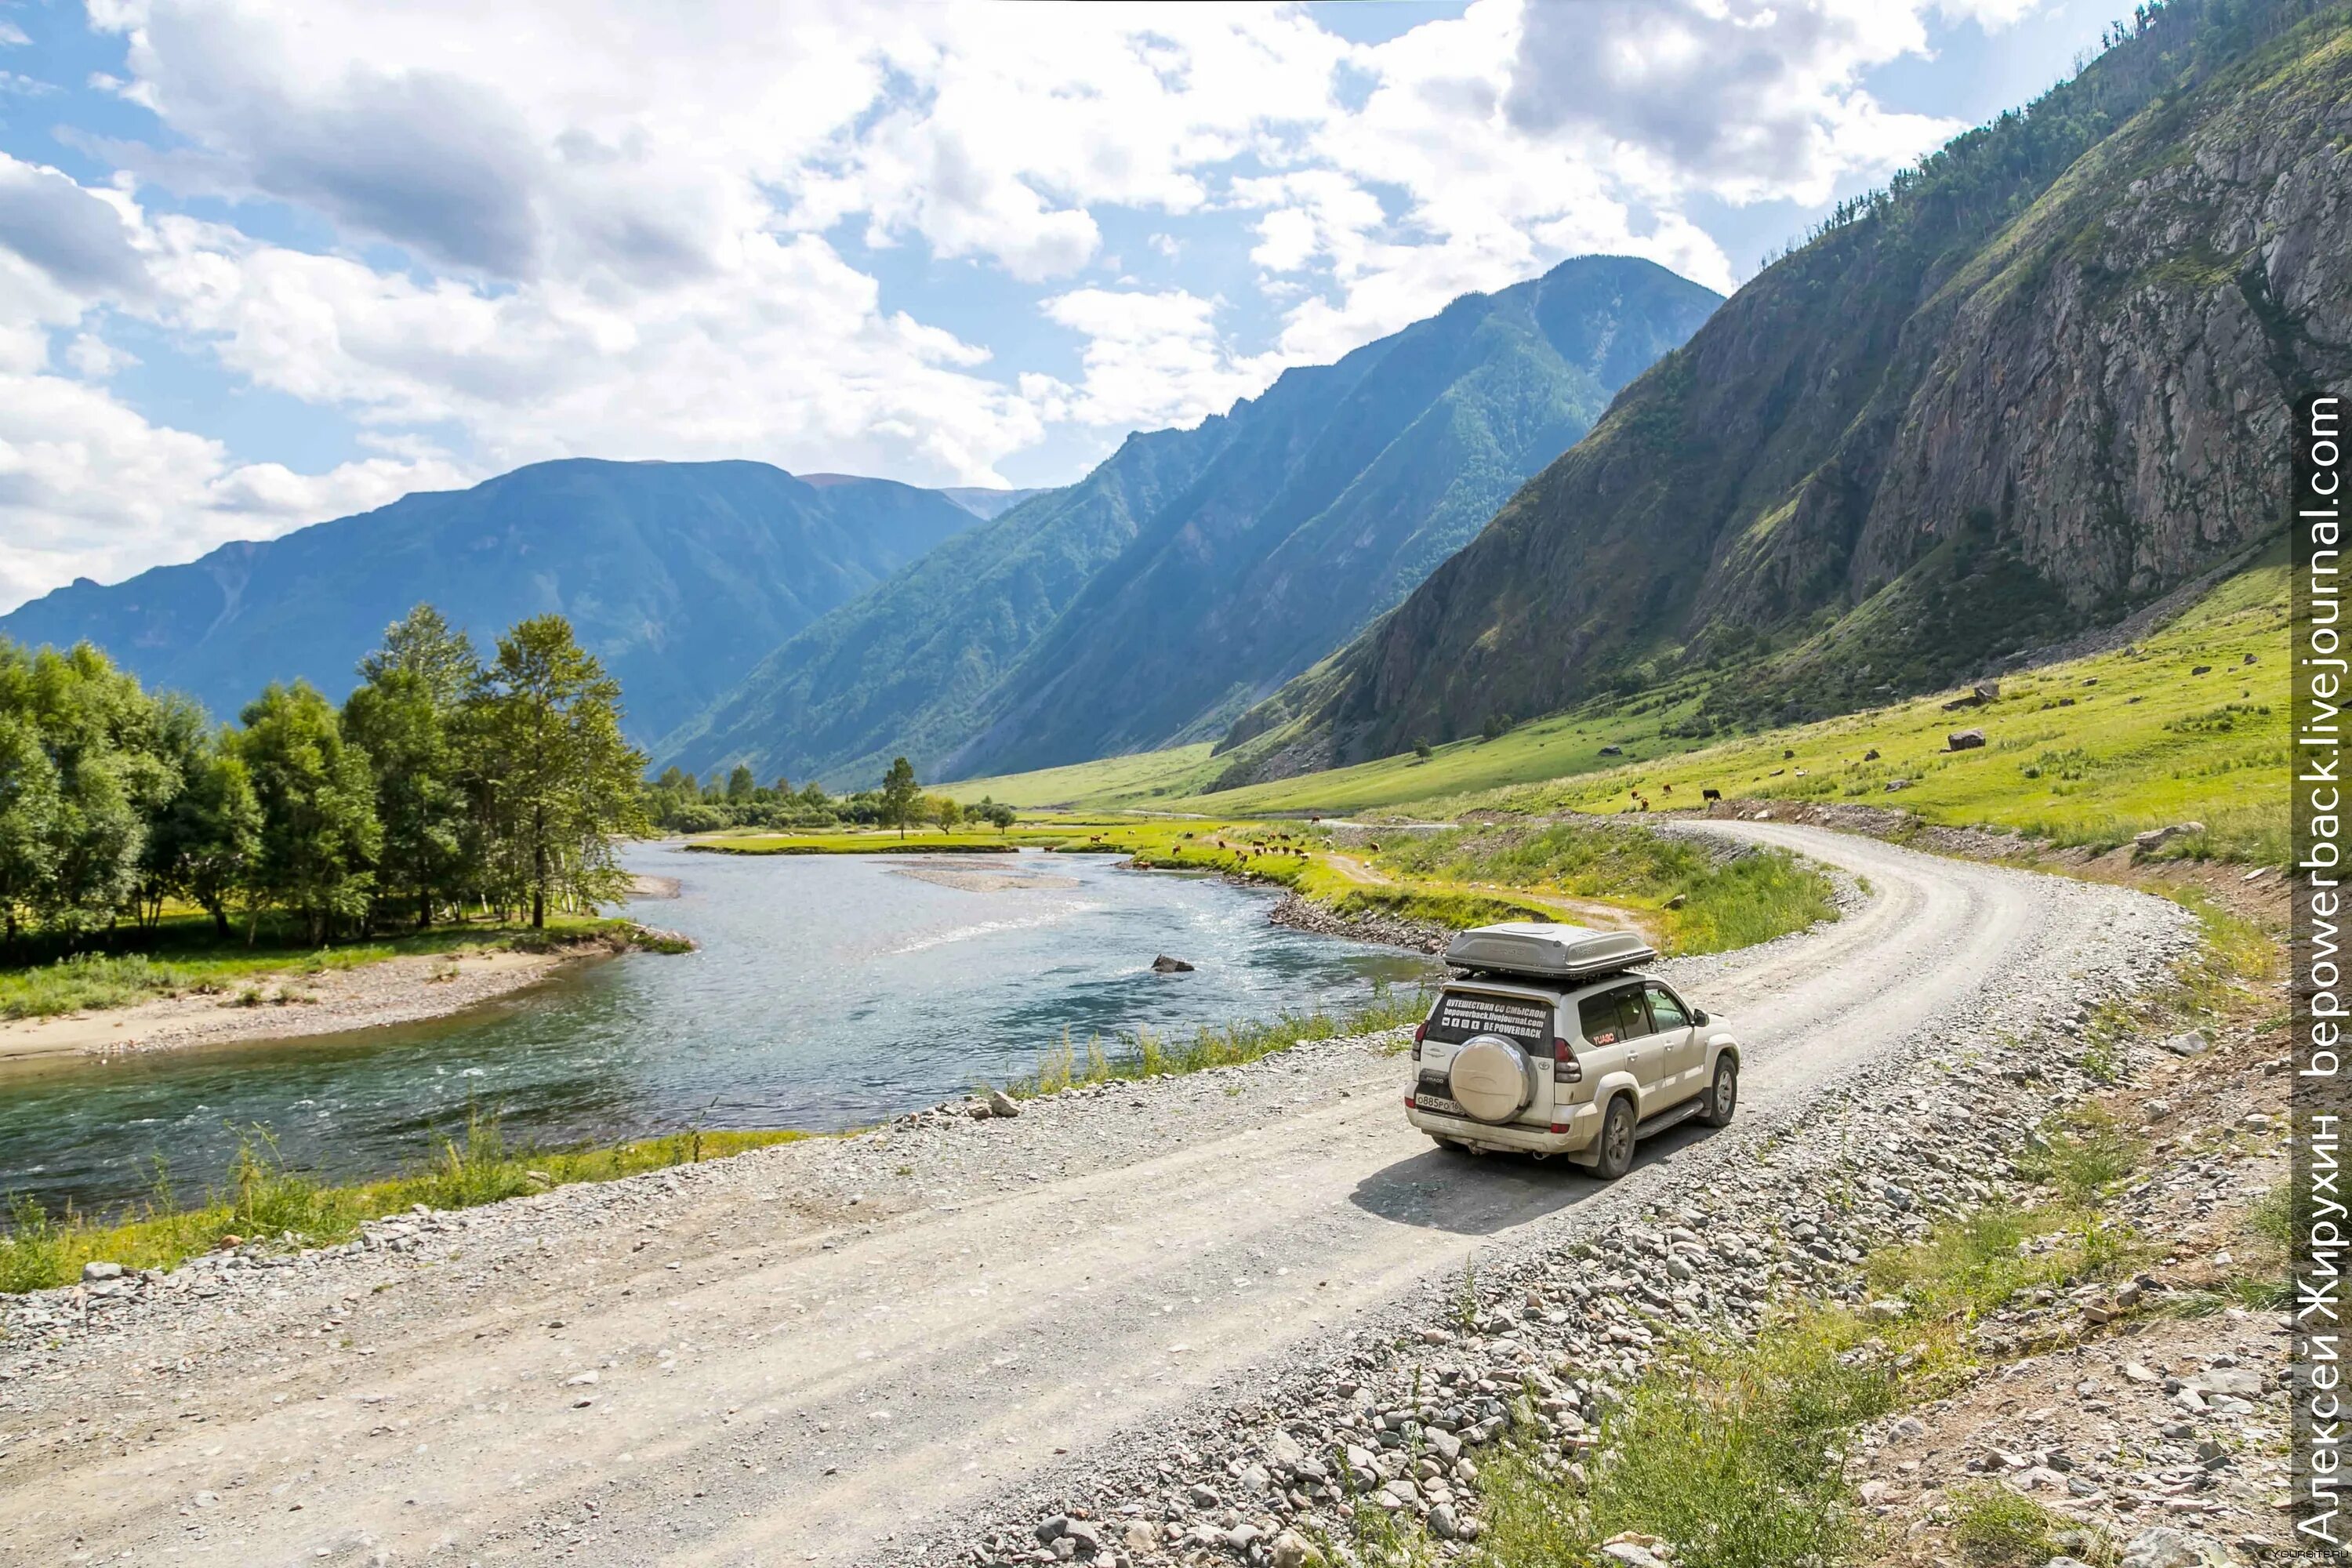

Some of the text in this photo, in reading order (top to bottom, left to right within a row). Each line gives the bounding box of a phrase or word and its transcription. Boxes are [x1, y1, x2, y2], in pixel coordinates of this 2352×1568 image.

[1443, 1007, 1544, 1029] bepowerback.livejournal.com
[1446, 999, 1547, 1019] ПУТЕШЕСТВИЯ СО СМЫСЛОМ
[1483, 1022, 1543, 1039] BE POWERBACK
